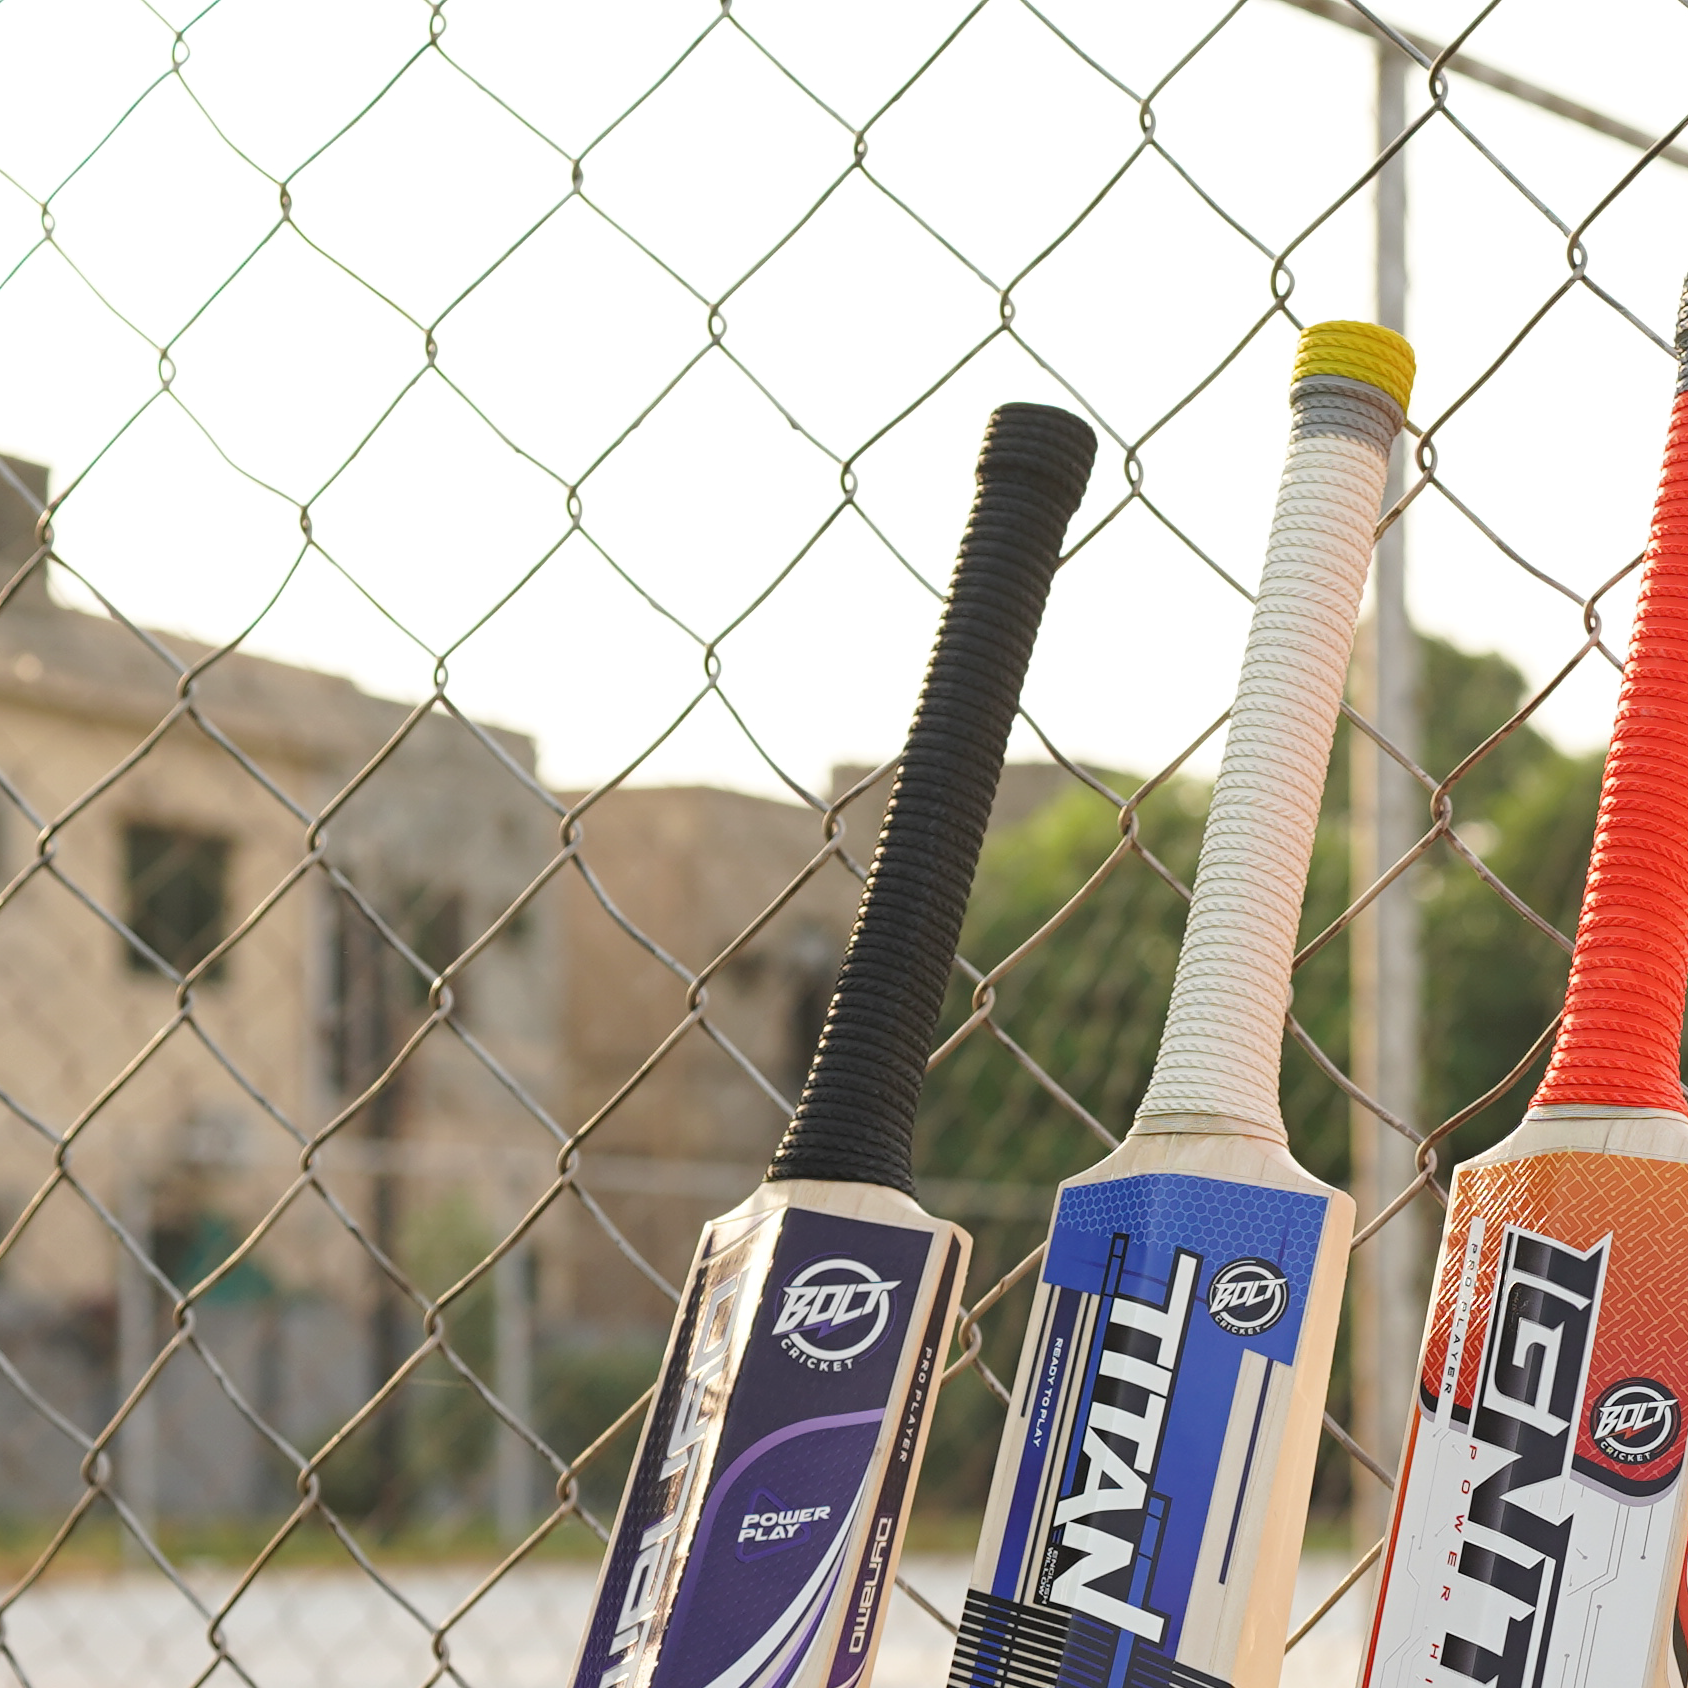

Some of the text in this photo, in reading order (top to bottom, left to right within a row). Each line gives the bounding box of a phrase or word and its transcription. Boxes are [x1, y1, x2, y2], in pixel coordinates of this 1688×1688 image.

[771, 1280, 903, 1337] BOLT
[1209, 1278, 1288, 1314] BOLT
[1443, 1243, 1479, 1394] PRO PLAYER
[1215, 1315, 1261, 1335] CRICKET
[781, 1338, 854, 1372] CRICKET
[899, 1346, 932, 1463] PRO PLAYER
[1033, 1337, 1064, 1448] READY TO PLAY
[1593, 1399, 1679, 1440] BOLT
[1050, 1253, 1198, 1644] TITAN
[1600, 1441, 1651, 1462] CRICKET
[737, 1523, 801, 1543] PLAY
[741, 1505, 832, 1529] POWER
[1440, 1444, 1477, 1601] POWER
[1038, 1546, 1053, 1595] WILLOW
[1041, 1550, 1058, 1604] ENGLISH
